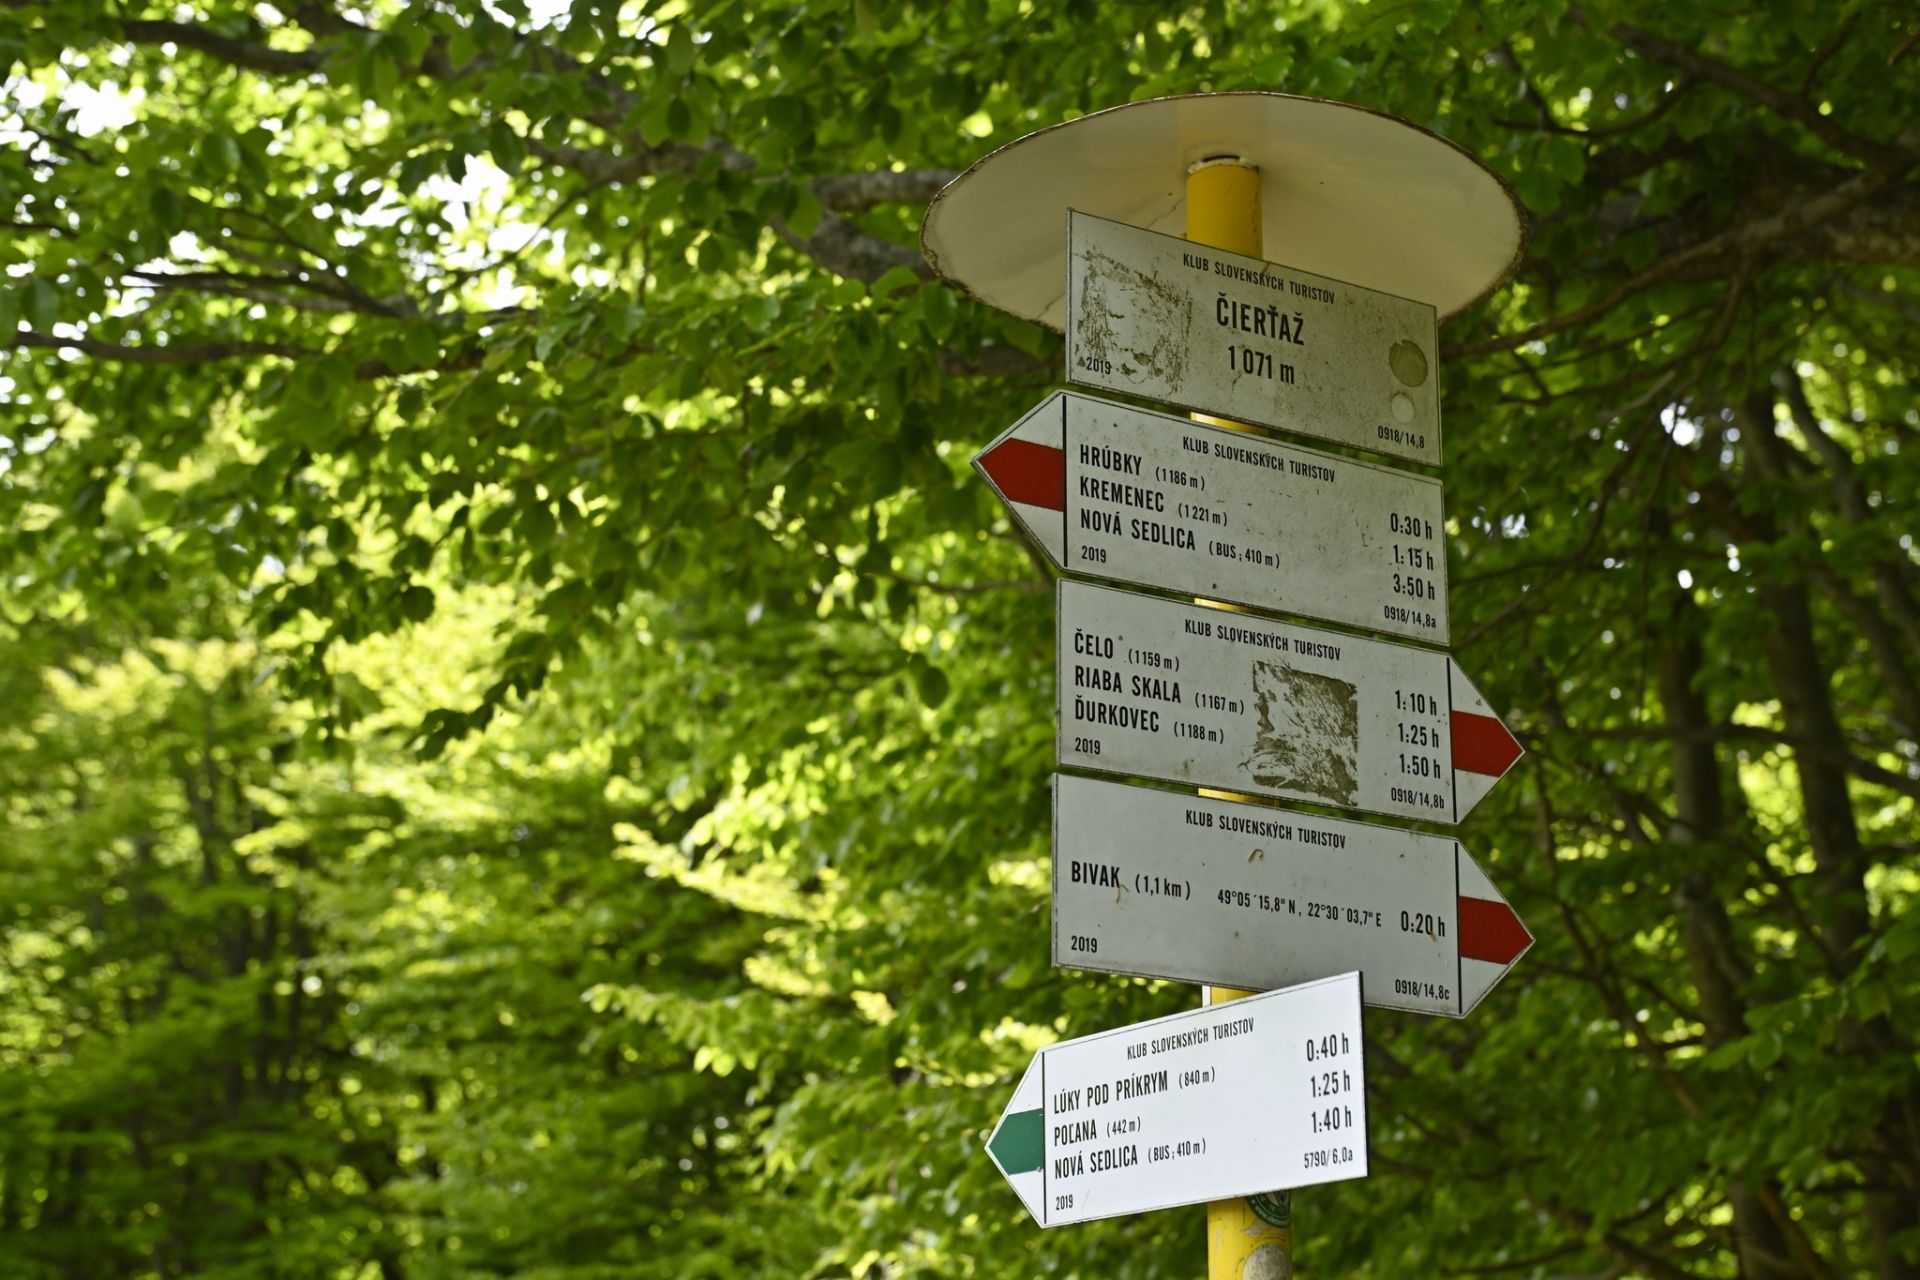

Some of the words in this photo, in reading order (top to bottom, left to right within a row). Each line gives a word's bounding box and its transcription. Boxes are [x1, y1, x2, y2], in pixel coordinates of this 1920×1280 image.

[1183, 252, 1209, 271] KLUB
[1214, 261, 1284, 292] SLOVENSKÝCH
[1290, 281, 1335, 305] TURISTOV
[1216, 291, 1305, 346] ČIERŤAŽ
[1086, 356, 1112, 375] 2019
[1080, 444, 1142, 476] HRÚBKY
[1183, 436, 1209, 455] KLUB
[1214, 443, 1284, 472] SLOVENSKÝCH
[1289, 459, 1335, 483] TURISTOV
[1080, 476, 1164, 512] KREMENEC
[1080, 508, 1122, 536] NOVÁ
[1131, 519, 1196, 550] SEDLICA
[1081, 545, 1107, 563] 2019
[1075, 628, 1114, 659] ČELO
[1185, 619, 1212, 637] KLUB
[1217, 625, 1289, 652] SLOVENSKÝCH
[1294, 639, 1341, 661] TURISTOV
[1075, 665, 1122, 693] RIABA
[1131, 675, 1181, 703] SKALA
[1075, 694, 1160, 733] ĎURKOVEC
[1075, 737, 1101, 755] 2019
[1186, 809, 1213, 827] KLUB
[1219, 815, 1292, 841] SLOVENSKÝCH
[1298, 828, 1346, 849] TURISTOV
[1071, 861, 1120, 888] BIVAK
[1164, 878, 1191, 900] km)
[1071, 935, 1098, 953] 2019
[1127, 1043, 1148, 1060] KLUB
[1151, 1028, 1209, 1055] SLOVENSKÝCH
[1213, 1018, 1254, 1041] TURISTOV
[1054, 1088, 1081, 1115] LÚKY
[1087, 1083, 1110, 1108] POD
[1116, 1070, 1168, 1101] PRÍKRYM
[1054, 1119, 1097, 1147] POĽANA
[1055, 1151, 1084, 1180] NOVÁ
[1090, 1144, 1139, 1174] SEDLICA
[1056, 1194, 1074, 1211] 2019
